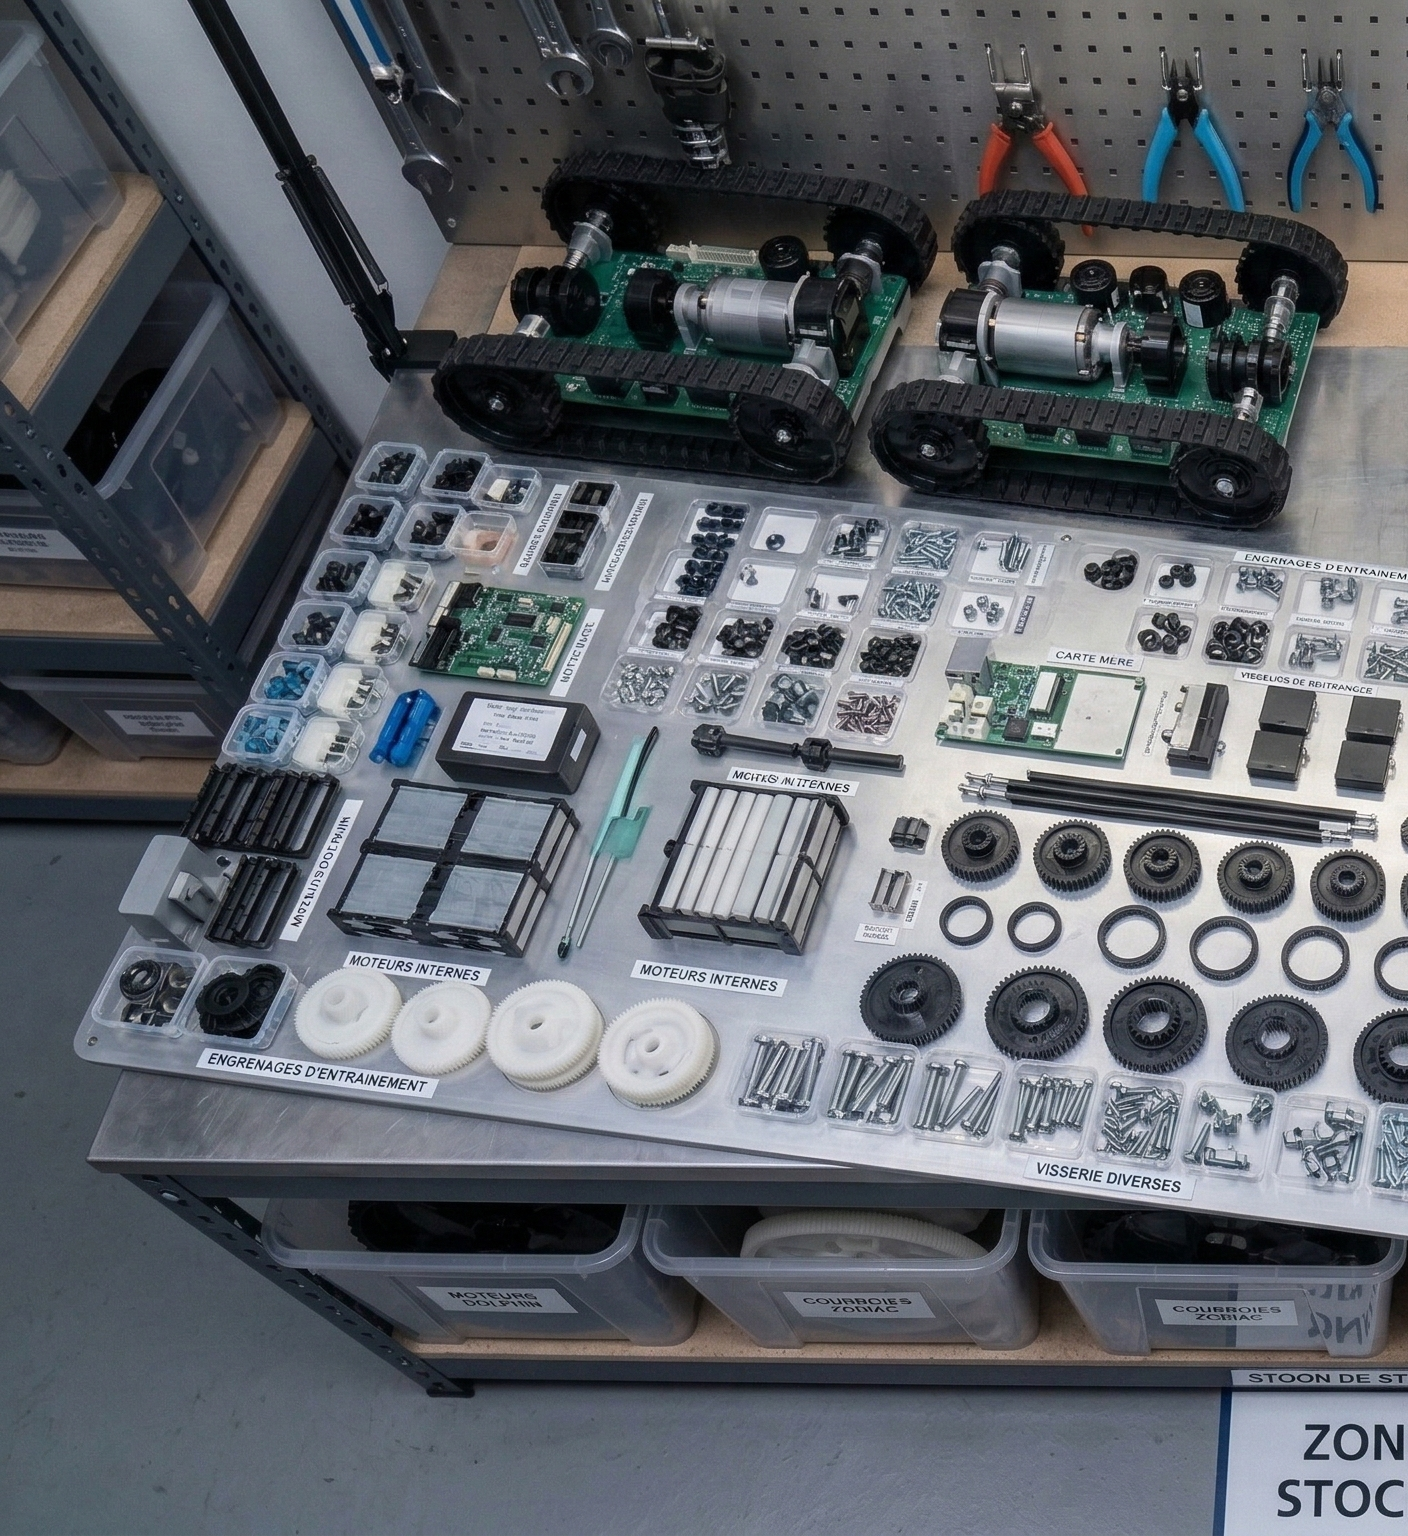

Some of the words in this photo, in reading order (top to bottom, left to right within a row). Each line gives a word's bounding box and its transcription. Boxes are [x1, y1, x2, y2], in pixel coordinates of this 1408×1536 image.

[1055, 650, 1096, 663] CARTE
[349, 954, 414, 973] MOTEURS
[414, 963, 481, 982] INTERNES
[639, 964, 707, 983] MOTEURS
[709, 973, 779, 993] INTERNES
[207, 1052, 303, 1076] ENGRENAGES
[304, 1065, 428, 1093] D'ENTRAINEMENT
[1036, 1162, 1104, 1183] VISSERIE
[1106, 1172, 1182, 1193] DIVERSES
[1248, 1373, 1330, 1384] STOON
[1339, 1373, 1371, 1384] DE
